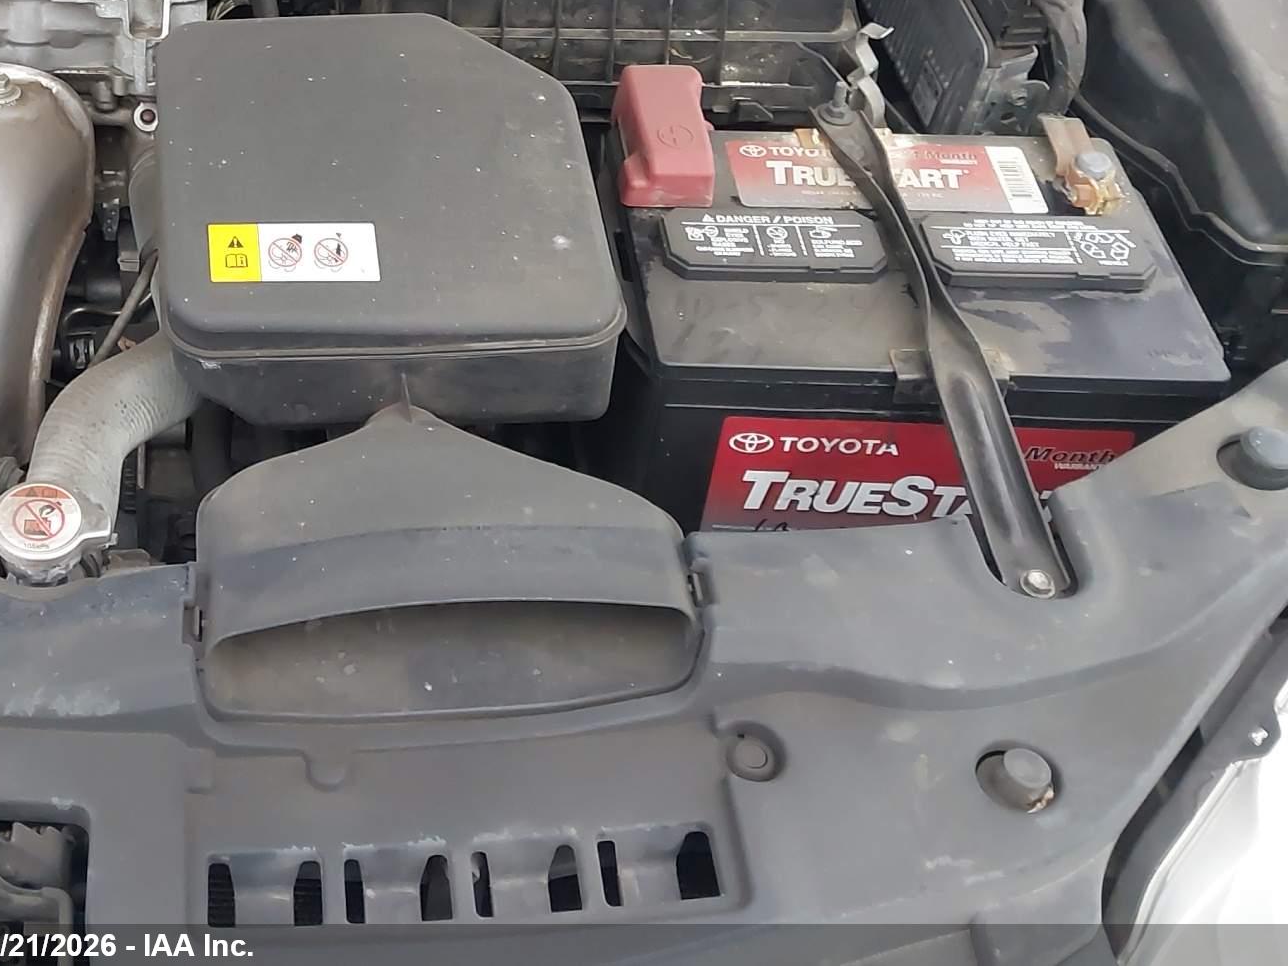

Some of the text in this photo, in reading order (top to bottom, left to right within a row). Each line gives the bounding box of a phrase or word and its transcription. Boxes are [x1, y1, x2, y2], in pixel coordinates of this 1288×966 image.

[715, 215, 772, 224] DANGER
[783, 216, 834, 225] POISON
[780, 436, 900, 457] TOYOTA
